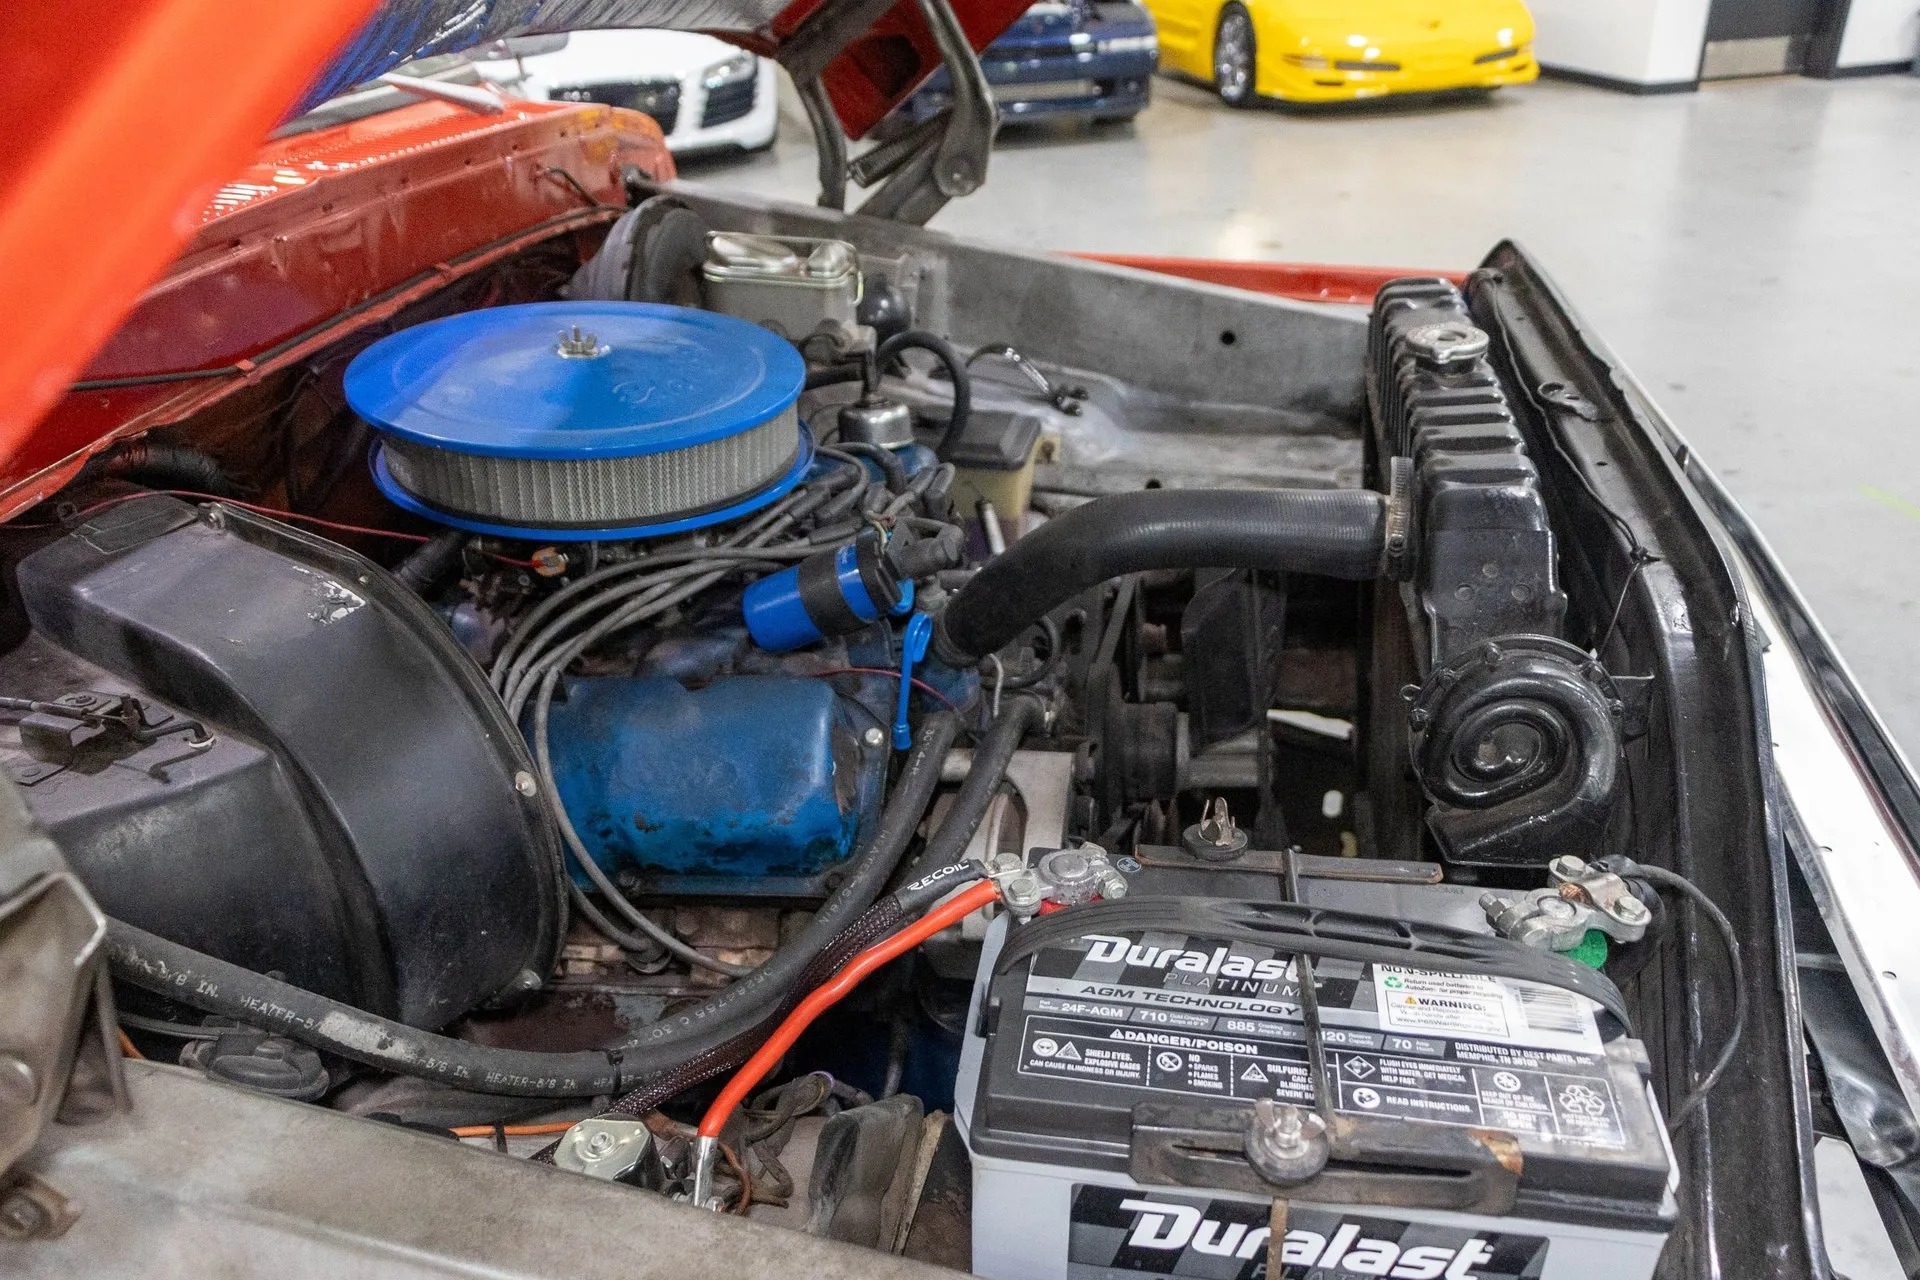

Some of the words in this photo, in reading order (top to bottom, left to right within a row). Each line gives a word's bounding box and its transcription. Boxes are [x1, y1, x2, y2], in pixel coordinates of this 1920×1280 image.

[907, 860, 970, 890] RECOIL
[1163, 972, 1299, 997] PLATINUM
[1081, 985, 1135, 999] AGM
[1142, 991, 1299, 1016] TECHNOLOGY
[1418, 997, 1486, 1012] WARNING:
[241, 995, 322, 1033] HEATER-5/
[1061, 1002, 1123, 1018] 24F-AGM
[1139, 1010, 1167, 1023] 710
[1227, 1020, 1255, 1032] 885
[1125, 1031, 1258, 1055] DANGER/POISON
[1321, 1031, 1346, 1042] 120
[1392, 1038, 1412, 1050] 70
[1085, 1048, 1111, 1059] SHIELD
[1111, 1051, 1133, 1062] EYES.
[1188, 1053, 1201, 1063] NO
[1454, 1042, 1509, 1055] DISTRIBUTED
[1510, 1048, 1522, 1057] BY
[1524, 1049, 1544, 1060] BEST
[1577, 1056, 1595, 1066] INC.
[1456, 1051, 1499, 1064] MEMPHIS,
[1499, 1055, 1512, 1065] TN
[1029, 1059, 1044, 1067] CAN
[1044, 1061, 1066, 1070] CAUSE
[1067, 1063, 1104, 1075] BLINDNESS
[1104, 1068, 1115, 1076] OR
[1115, 1069, 1141, 1079] INJURY.
[1084, 1057, 1118, 1069] EXPLOSIVE
[1119, 1062, 1141, 1071] GASES
[1193, 1062, 1219, 1073] SPARKS
[1266, 1063, 1309, 1077] SULFURIC
[1380, 1058, 1401, 1067] FLUSH
[1401, 1060, 1418, 1070] EYES
[1418, 1063, 1461, 1074] IMMEDIATELY
[1193, 1070, 1219, 1081] FLAMES
[1291, 1074, 1307, 1084] CAN
[1380, 1066, 1398, 1075] WITH
[1423, 1071, 1437, 1080] GET
[1437, 1072, 1467, 1082] MEDICAL
[1381, 1074, 1399, 1083] HELP
[1193, 1078, 1224, 1089] SMOKING
[1280, 1080, 1315, 1092] BLINDNES
[1276, 1088, 1304, 1100] SEVERE
[1386, 1095, 1410, 1106] READ
[1410, 1098, 1474, 1114] INSTRUCTIONS.
[1119, 1199, 1493, 1280] Duralast
